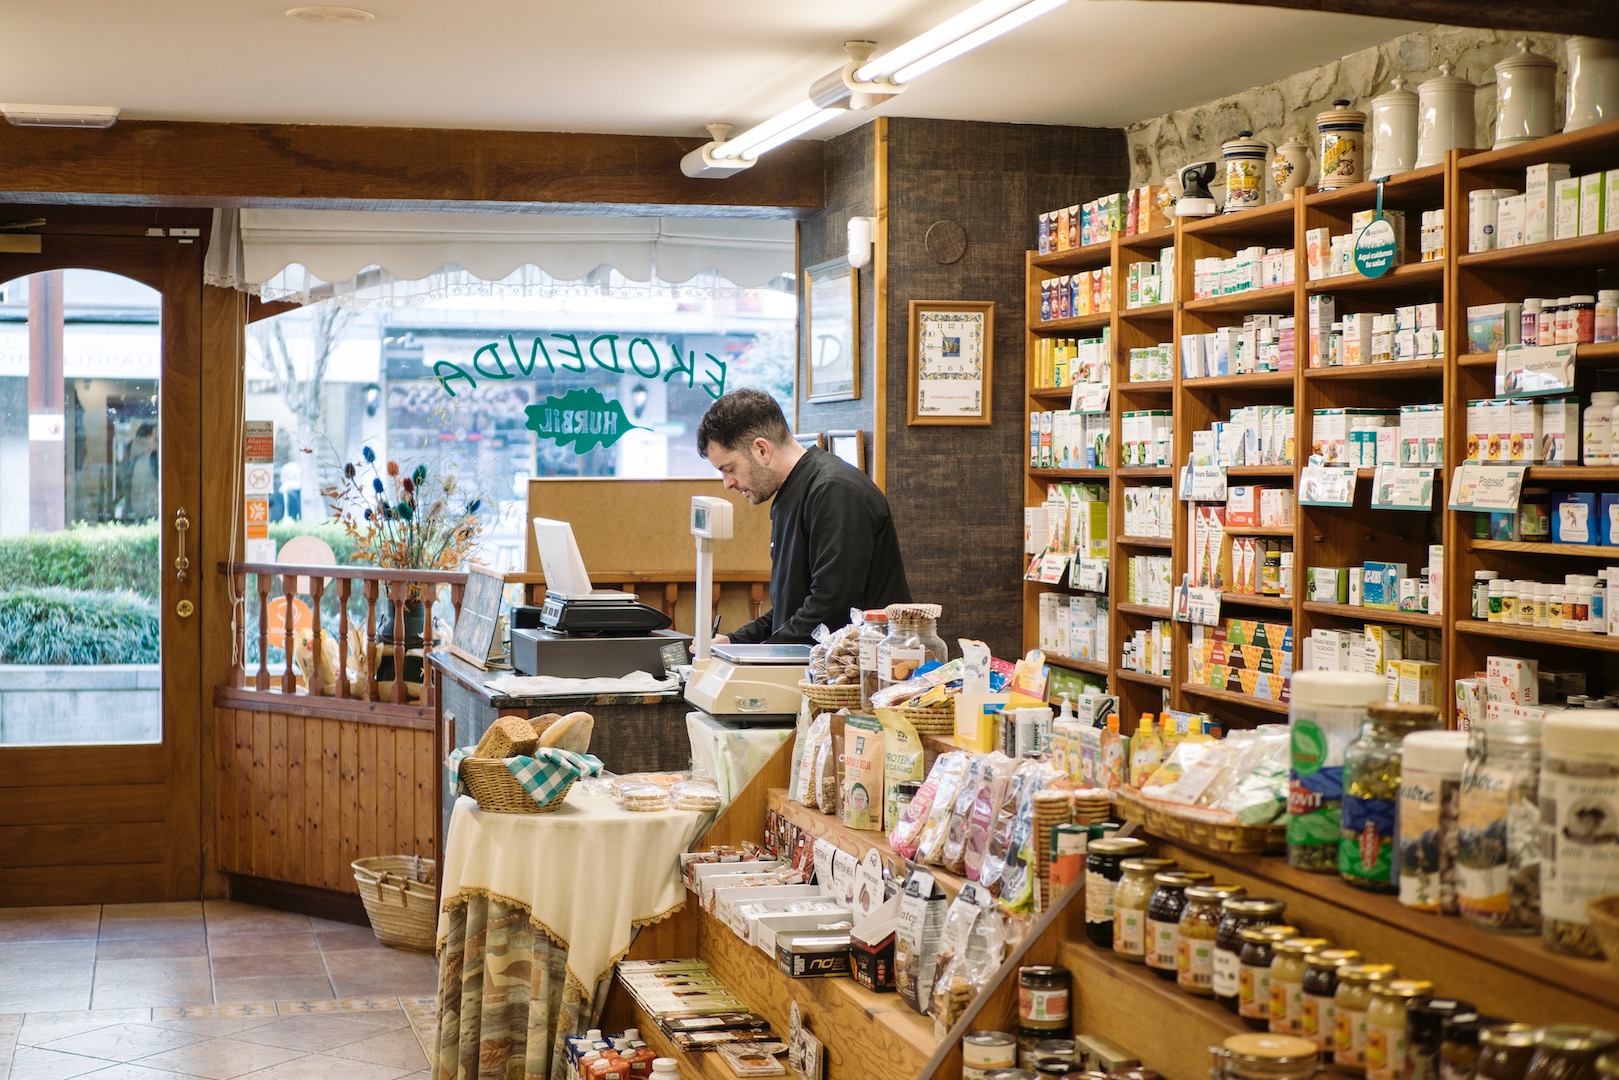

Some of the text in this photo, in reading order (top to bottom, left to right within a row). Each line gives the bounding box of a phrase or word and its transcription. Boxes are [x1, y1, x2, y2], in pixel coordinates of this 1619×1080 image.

[1372, 258, 1386, 267] salud
[1205, 470, 1219, 478] Balance
[1478, 476, 1504, 489] Pagosid
[1489, 668, 1500, 677] LRA
